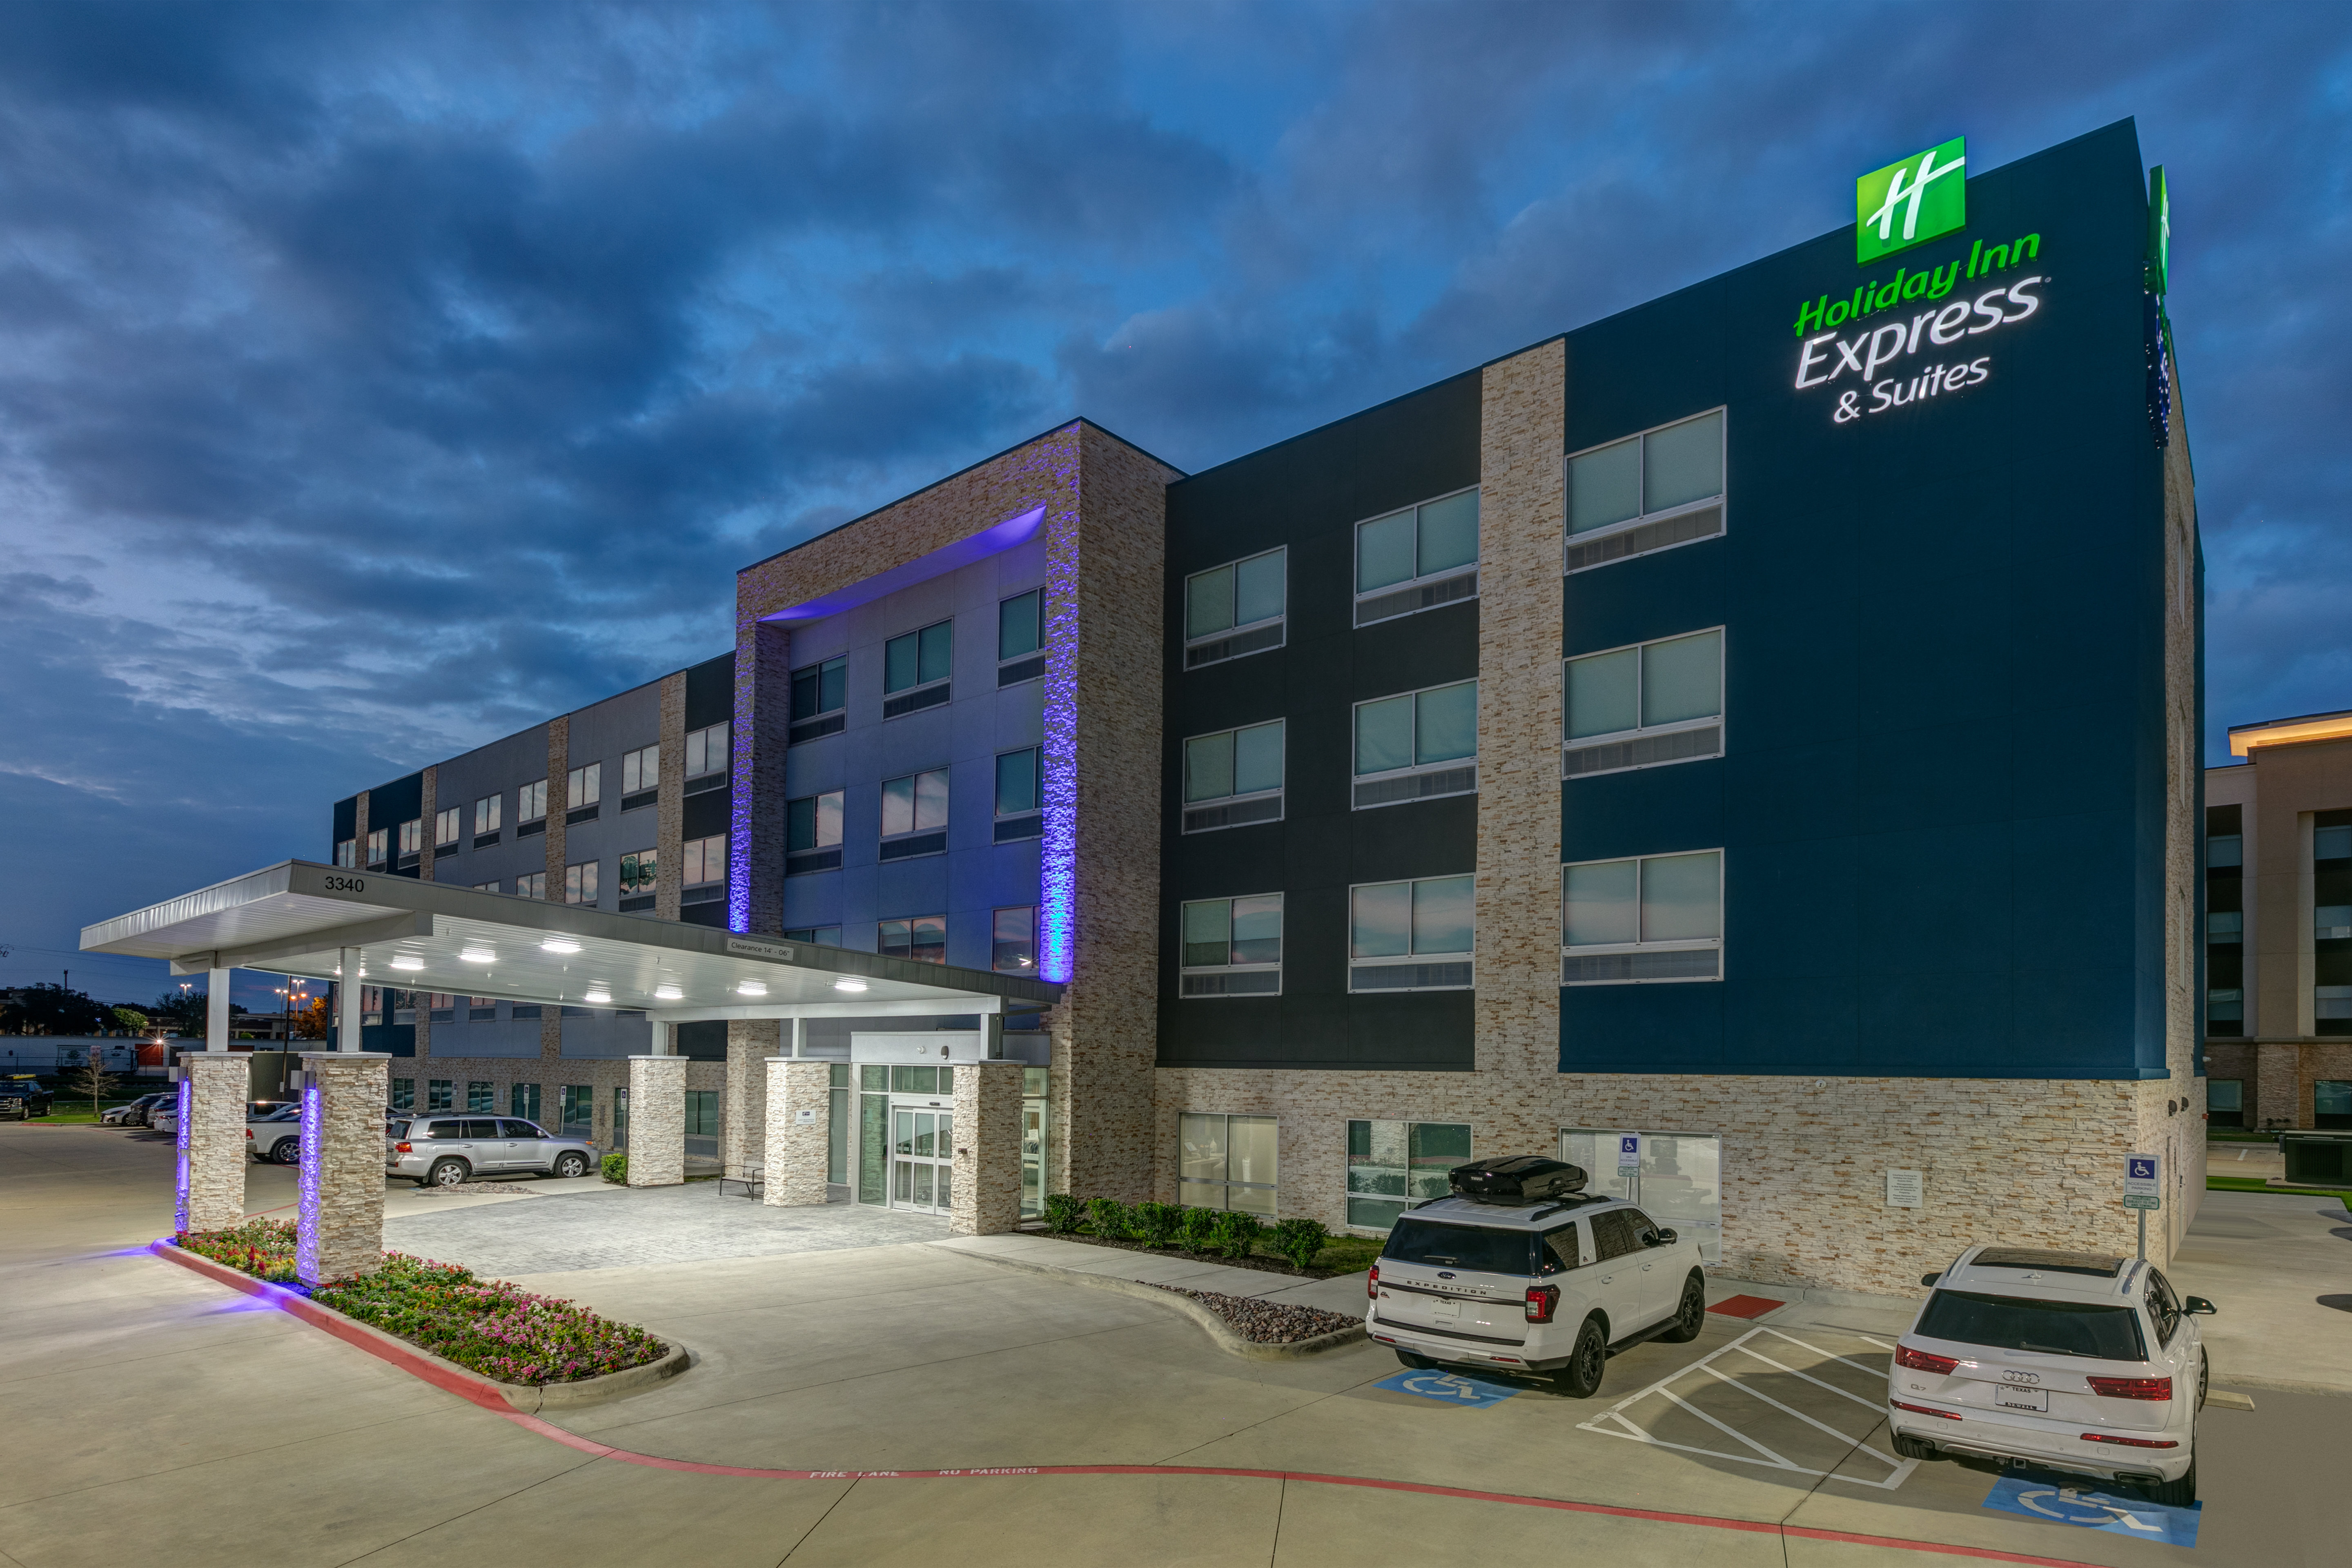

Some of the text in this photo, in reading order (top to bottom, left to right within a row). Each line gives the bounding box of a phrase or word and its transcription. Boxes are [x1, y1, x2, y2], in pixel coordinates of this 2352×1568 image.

[1793, 233, 2040, 336] Holiday Inn
[1795, 276, 2042, 389] Express
[1833, 356, 1990, 423] & Suites
[325, 876, 364, 892] 3340
[731, 942, 762, 952] Clearance
[1407, 1280, 1487, 1295] EXPEDITION
